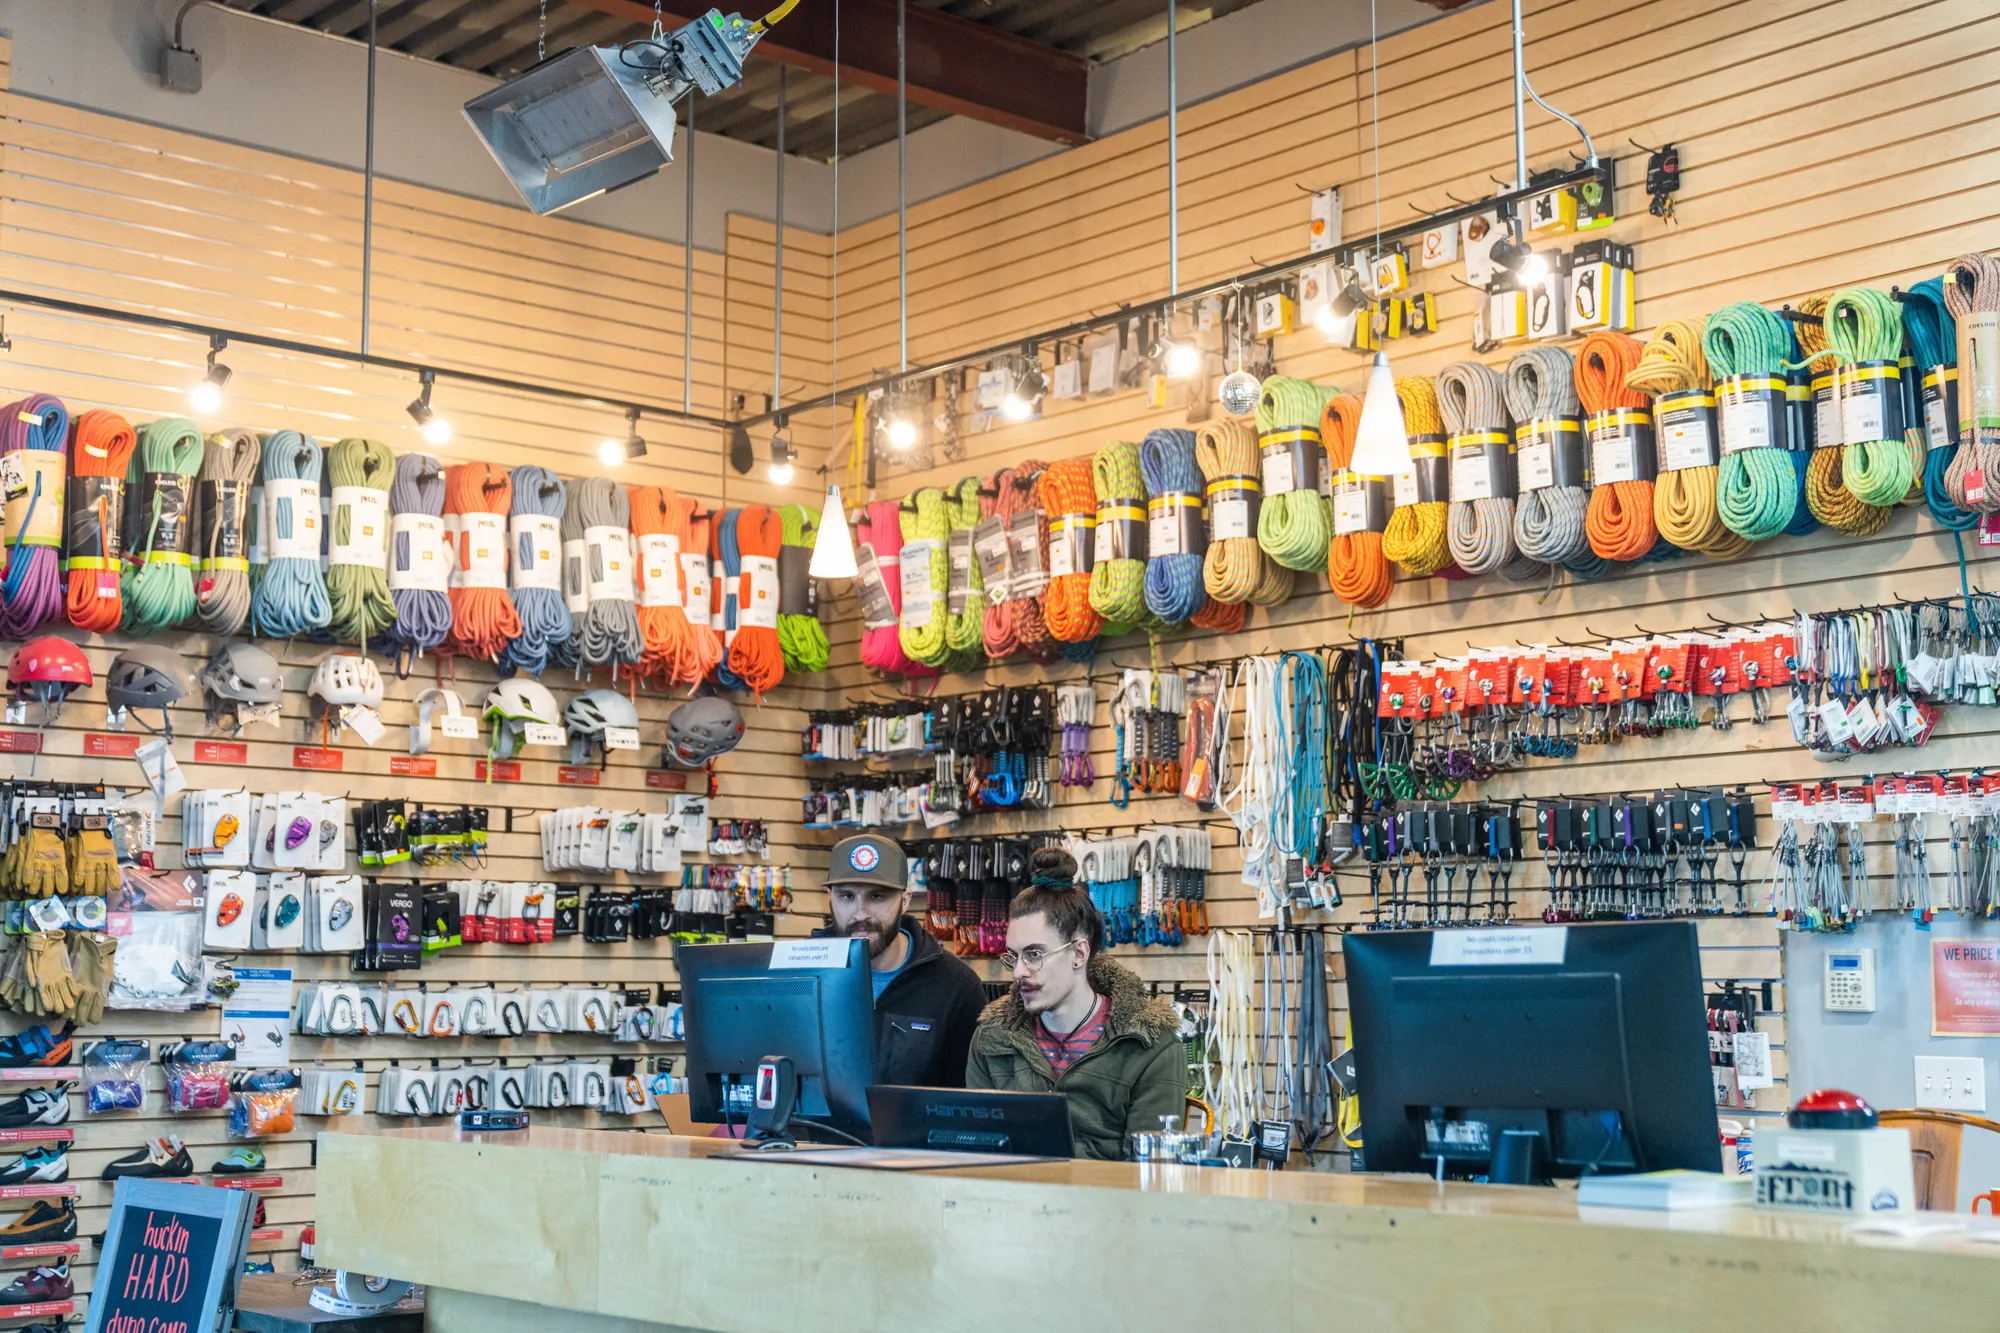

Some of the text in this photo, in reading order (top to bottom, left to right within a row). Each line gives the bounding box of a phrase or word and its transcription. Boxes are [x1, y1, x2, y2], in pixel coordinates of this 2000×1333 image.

[390, 899, 412, 908] VERGO
[1463, 947, 1501, 955] transactions
[1944, 948, 1993, 960] WE PRICE
[143, 1211, 189, 1254] huckin
[123, 1253, 189, 1303] HARD
